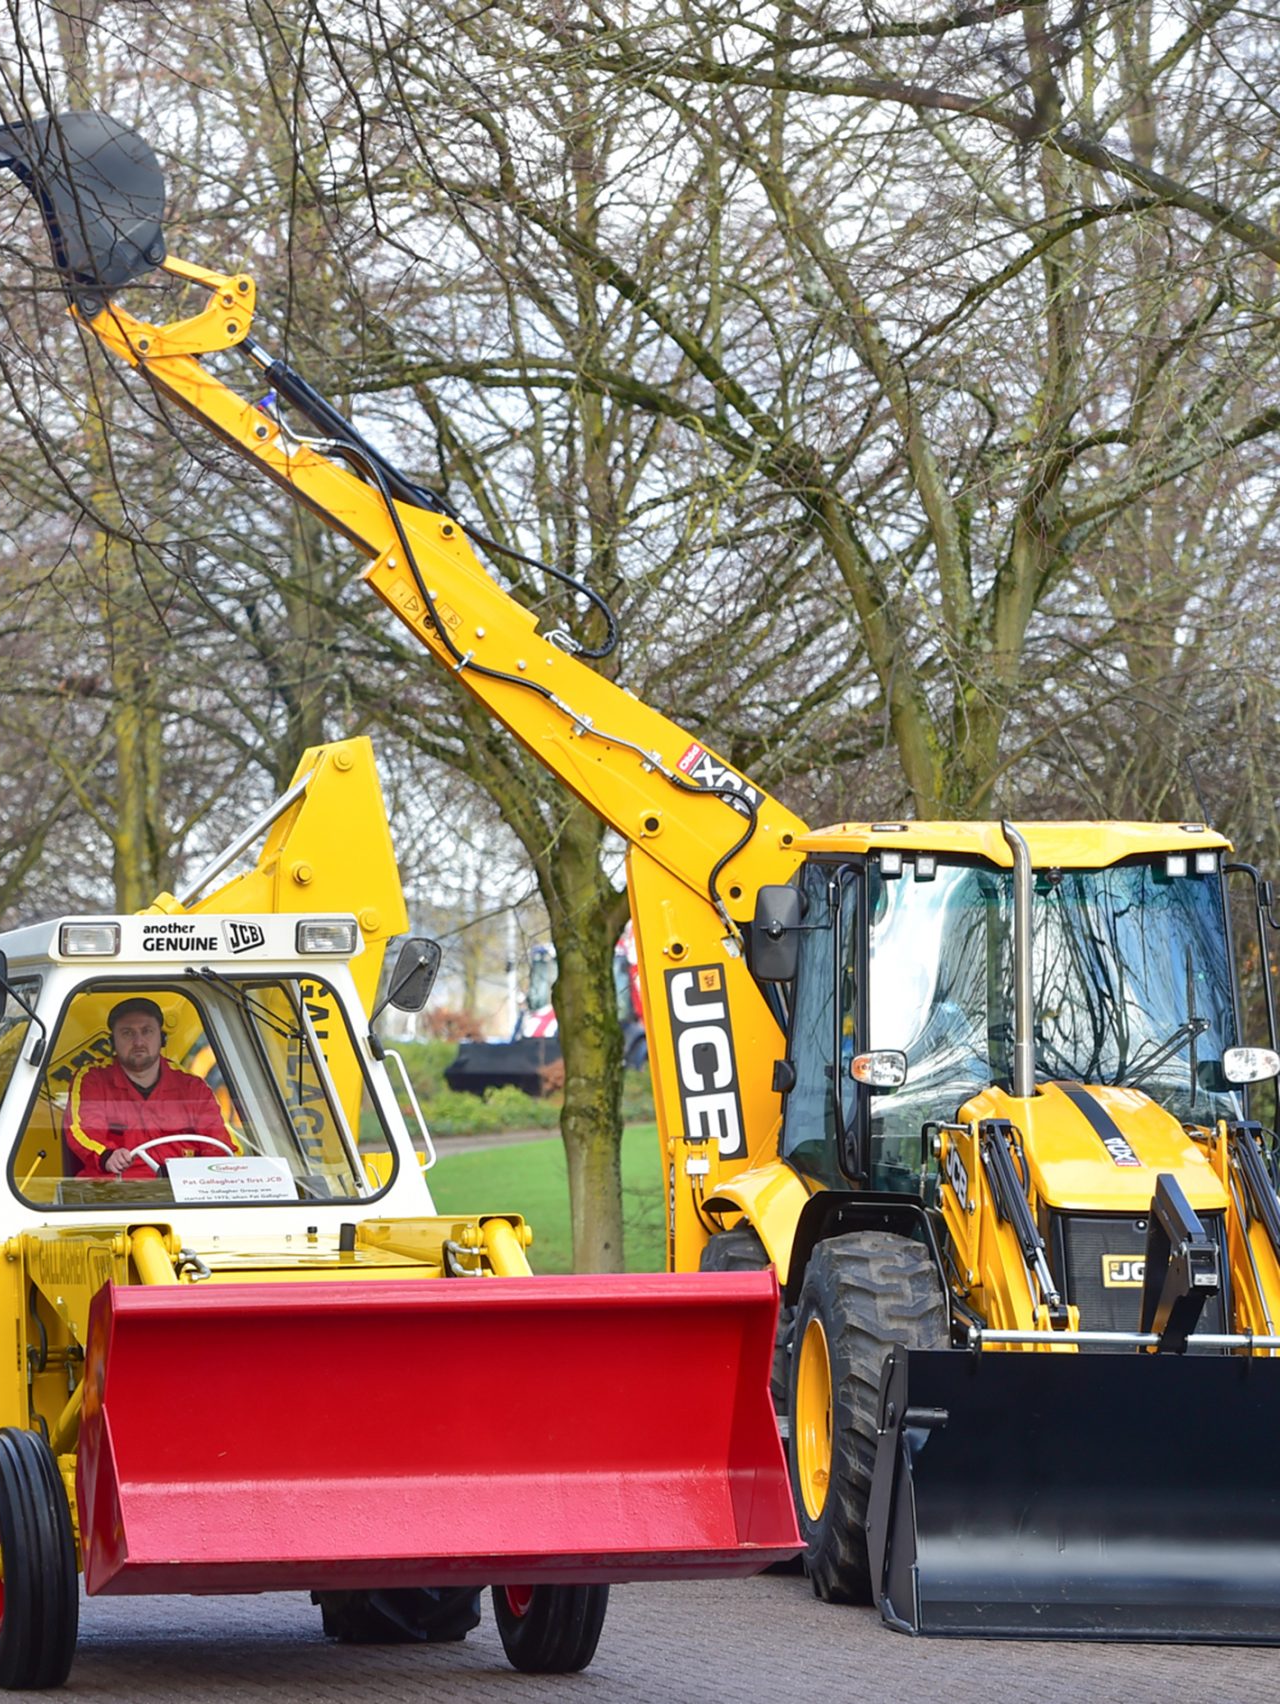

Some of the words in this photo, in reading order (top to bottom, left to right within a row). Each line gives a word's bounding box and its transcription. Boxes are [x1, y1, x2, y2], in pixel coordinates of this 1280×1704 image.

[143, 922, 195, 934] another
[143, 937, 218, 951] GENUINE
[229, 923, 259, 949] JCB
[671, 972, 740, 1154] JCB
[1103, 1138, 1136, 1161] 4CX
[1111, 1262, 1146, 1281] JC
